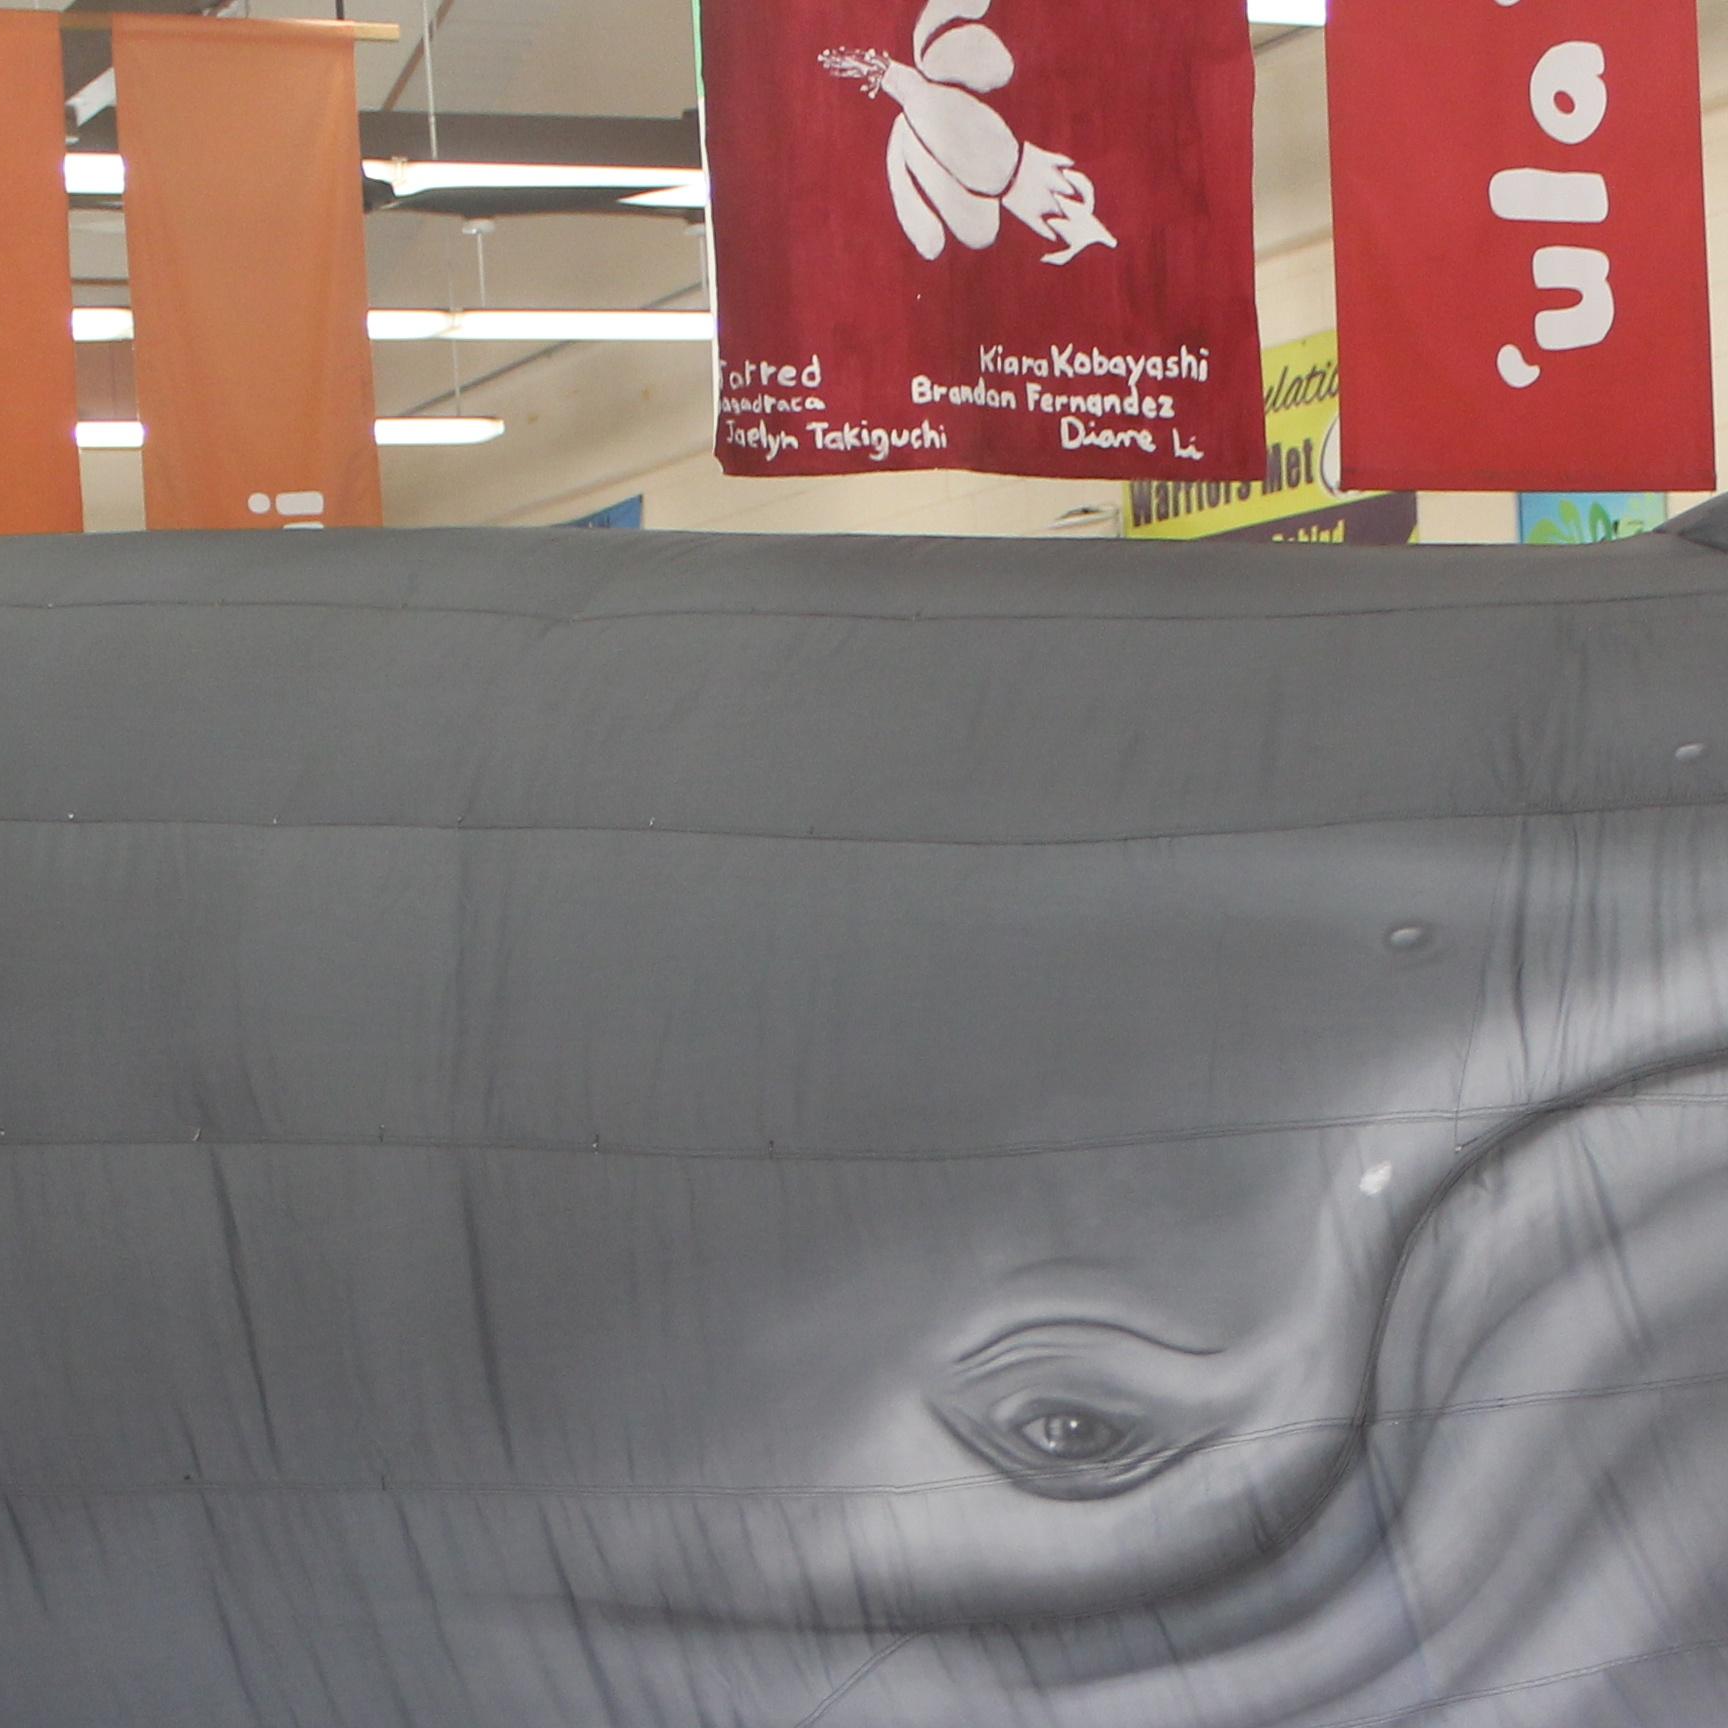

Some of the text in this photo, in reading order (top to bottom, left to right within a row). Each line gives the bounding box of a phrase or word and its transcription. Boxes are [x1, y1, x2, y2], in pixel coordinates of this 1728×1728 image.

[979, 343, 1209, 387] Kiara Kobayashi
[1026, 381, 1175, 419] Fernandez
[725, 418, 948, 462] Jaelyn Takiguchi
[1060, 415, 1205, 460] Diane Li
